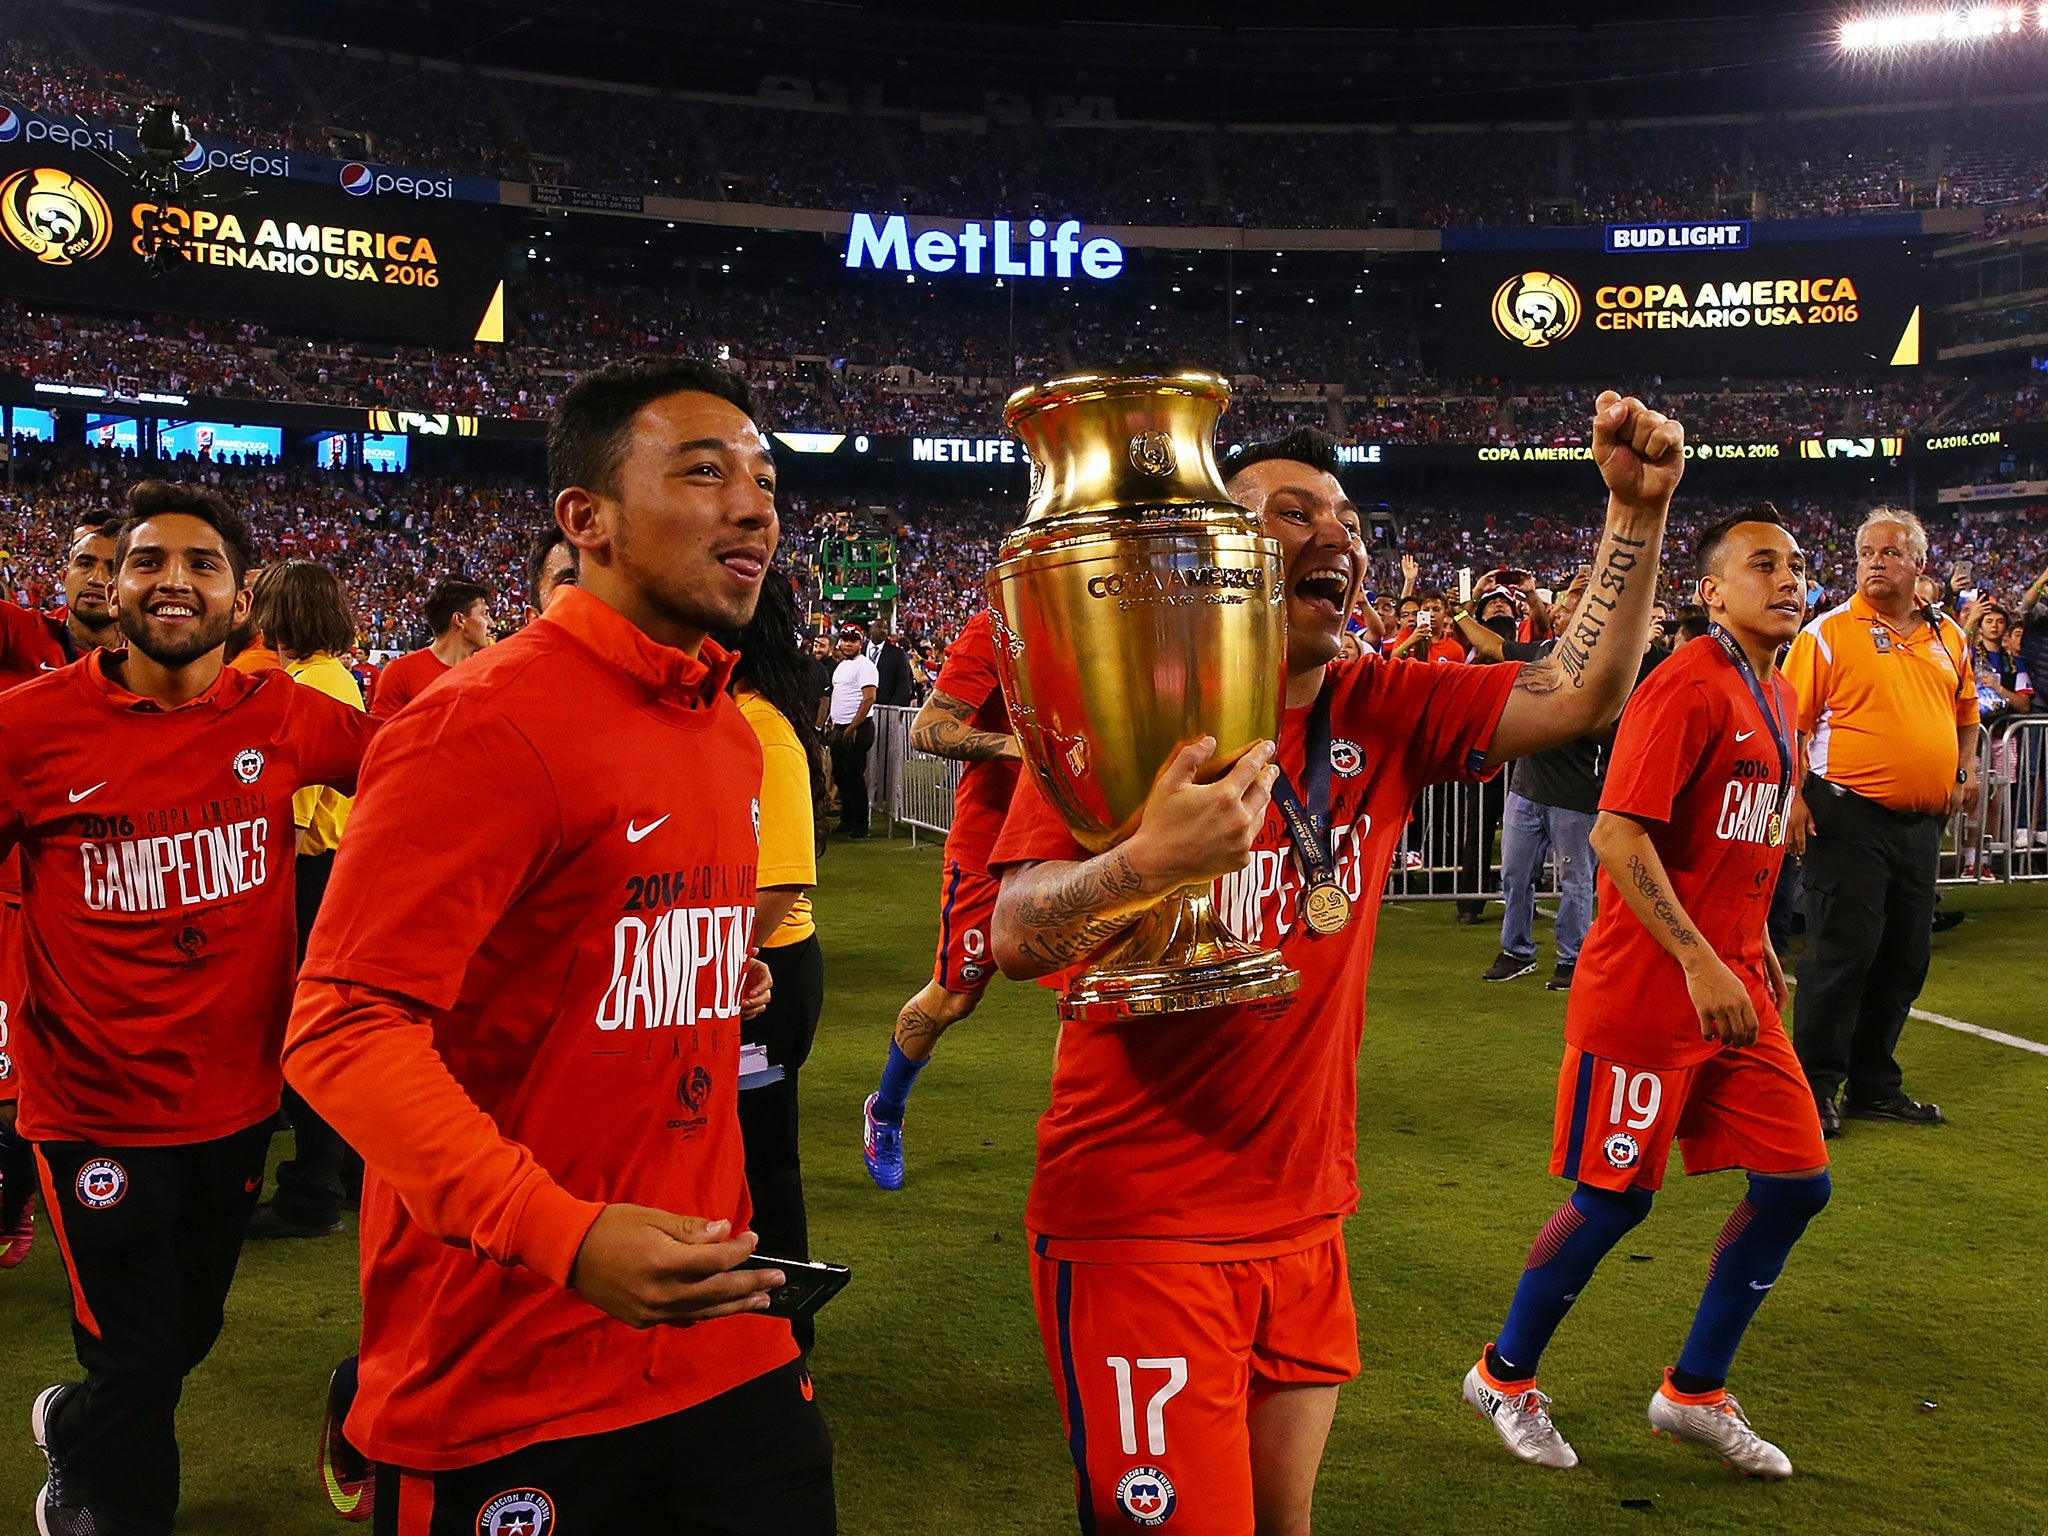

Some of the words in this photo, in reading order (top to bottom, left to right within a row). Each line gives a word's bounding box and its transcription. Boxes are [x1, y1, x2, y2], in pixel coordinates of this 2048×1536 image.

[26, 120, 113, 151] pepsi
[208, 150, 289, 177] pepsi
[376, 175, 453, 199] pepsi
[67, 238, 89, 254] 2016
[253, 219, 437, 264] AMERICA
[845, 212, 1123, 279] MetLife
[1613, 229, 1665, 247] BUD
[1668, 226, 1741, 245] LIGHT
[324, 257, 379, 282] USA
[385, 264, 439, 287] 2016
[1595, 284, 1688, 309] COPA
[1694, 278, 1858, 307] AMERICA
[1595, 308, 1750, 330] CENTENARIO
[1754, 307, 1803, 327] USA
[1808, 304, 1859, 324] 2016
[912, 438, 1016, 463] METLIFE
[1337, 446, 1381, 463] HILE
[1478, 447, 1520, 461] COPA
[1523, 447, 1594, 461] AMERICA
[1715, 445, 1745, 458] USA
[1747, 444, 1779, 458] 2016
[1926, 431, 2000, 450] CA2016.COM
[1557, 532, 1646, 688] Marisol
[1731, 759, 1769, 779] 2016
[78, 814, 135, 839] 2016
[147, 807, 190, 834] COPA
[201, 794, 267, 825] AMERICA
[80, 817, 268, 911] CAMPEONES
[963, 928, 985, 962] 9
[1609, 1065, 1662, 1130] 19
[1106, 1356, 1188, 1456] 17
[1116, 1467, 1145, 1499] FEDERACION
[1148, 1468, 1157, 1477] DE
[481, 1493, 519, 1527] FEDERACION
[524, 1493, 536, 1501] DE
